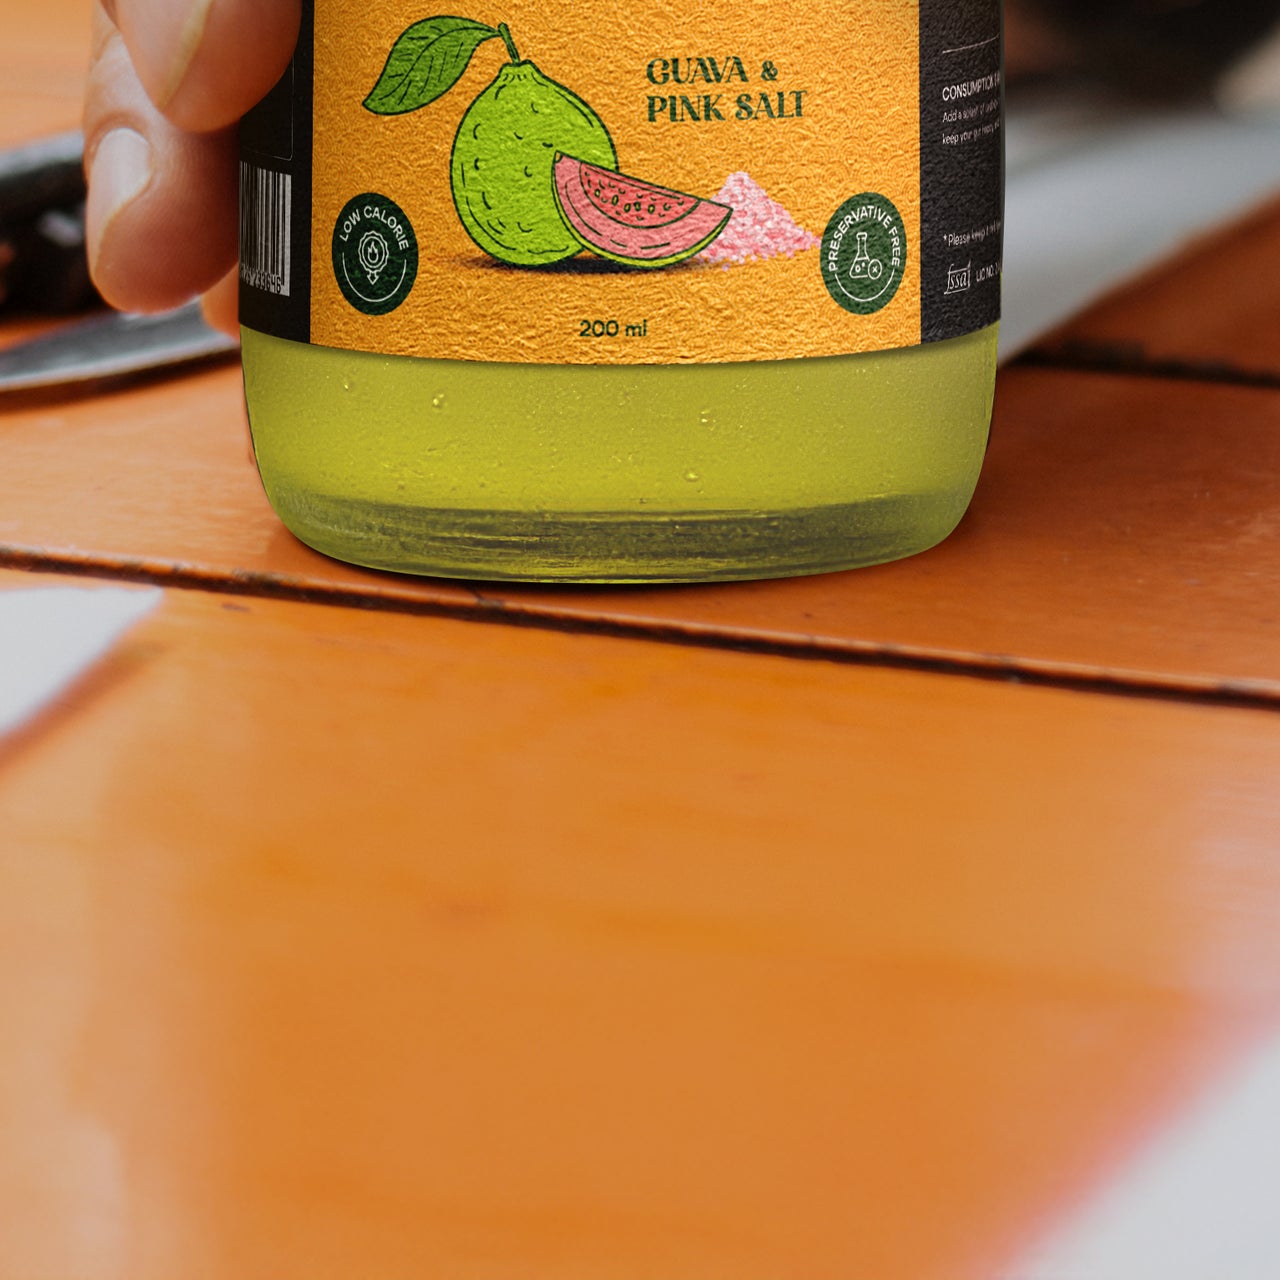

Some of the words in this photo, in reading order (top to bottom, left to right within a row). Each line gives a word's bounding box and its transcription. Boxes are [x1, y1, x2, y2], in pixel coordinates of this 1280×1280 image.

[646, 56, 749, 86] GUAVA
[760, 60, 779, 82] &
[646, 93, 726, 123] PINK
[735, 90, 808, 121] SALT
[942, 108, 958, 123] Add
[339, 208, 361, 242] LOW
[363, 205, 410, 251] CALORIE
[828, 205, 893, 272] PRESERVATIVE
[888, 225, 901, 268] FREE
[579, 319, 619, 337] 200
[625, 318, 647, 337] ml
